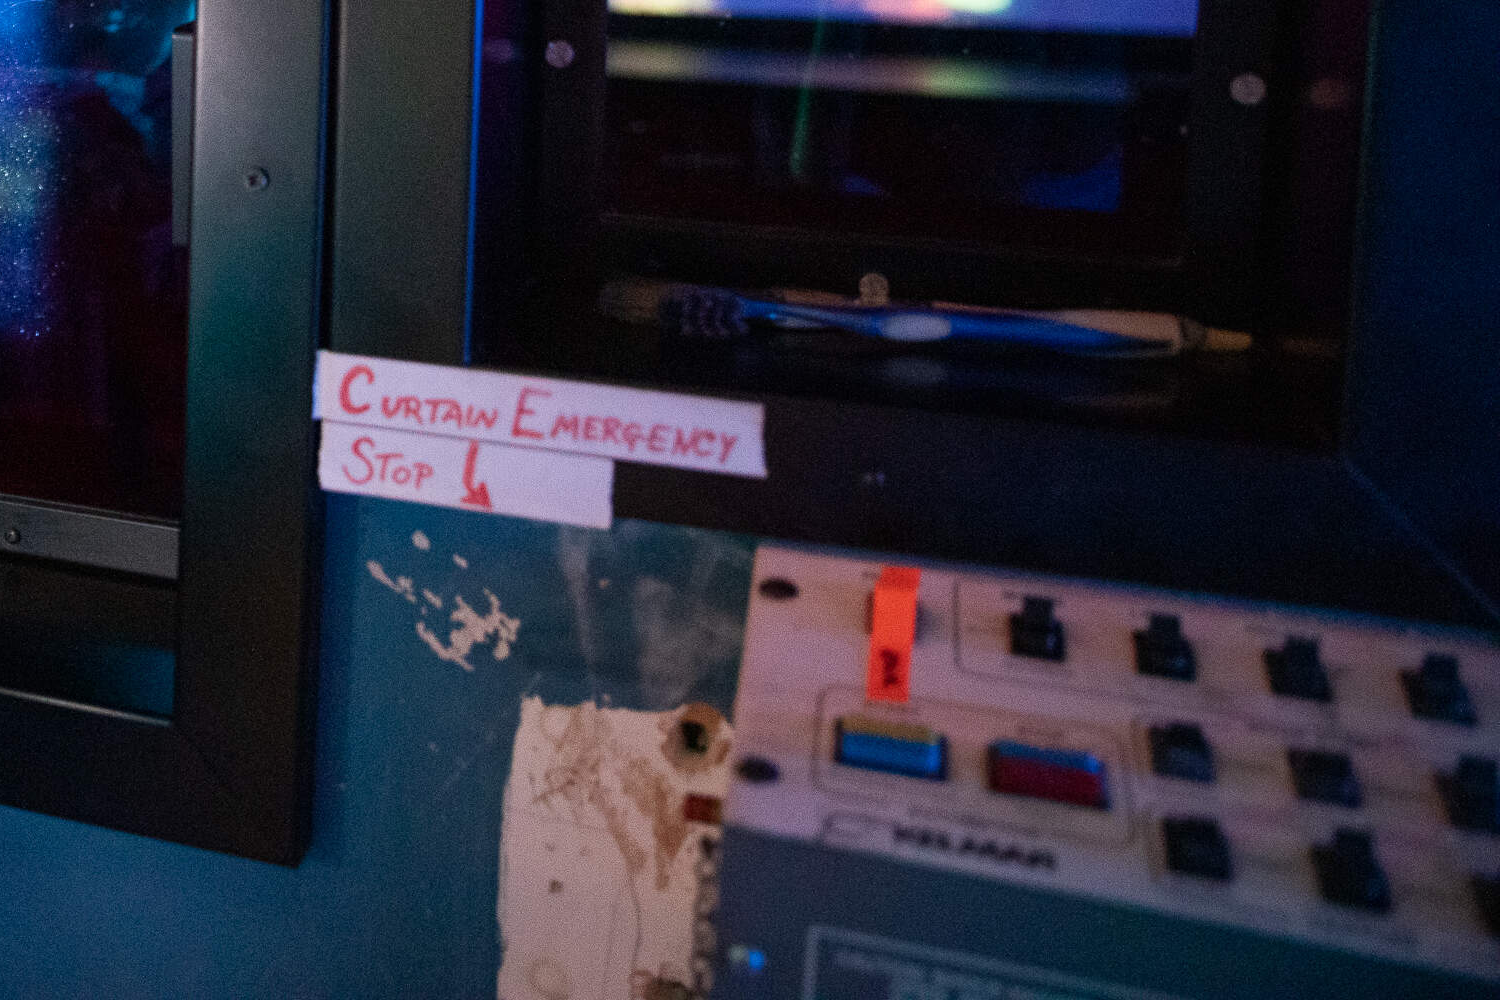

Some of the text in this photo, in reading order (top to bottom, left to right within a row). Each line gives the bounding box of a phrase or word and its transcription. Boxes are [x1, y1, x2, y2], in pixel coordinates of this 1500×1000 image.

[339, 365, 738, 463] CURTAIN EMERGENCY
[342, 437, 434, 489] STOP
